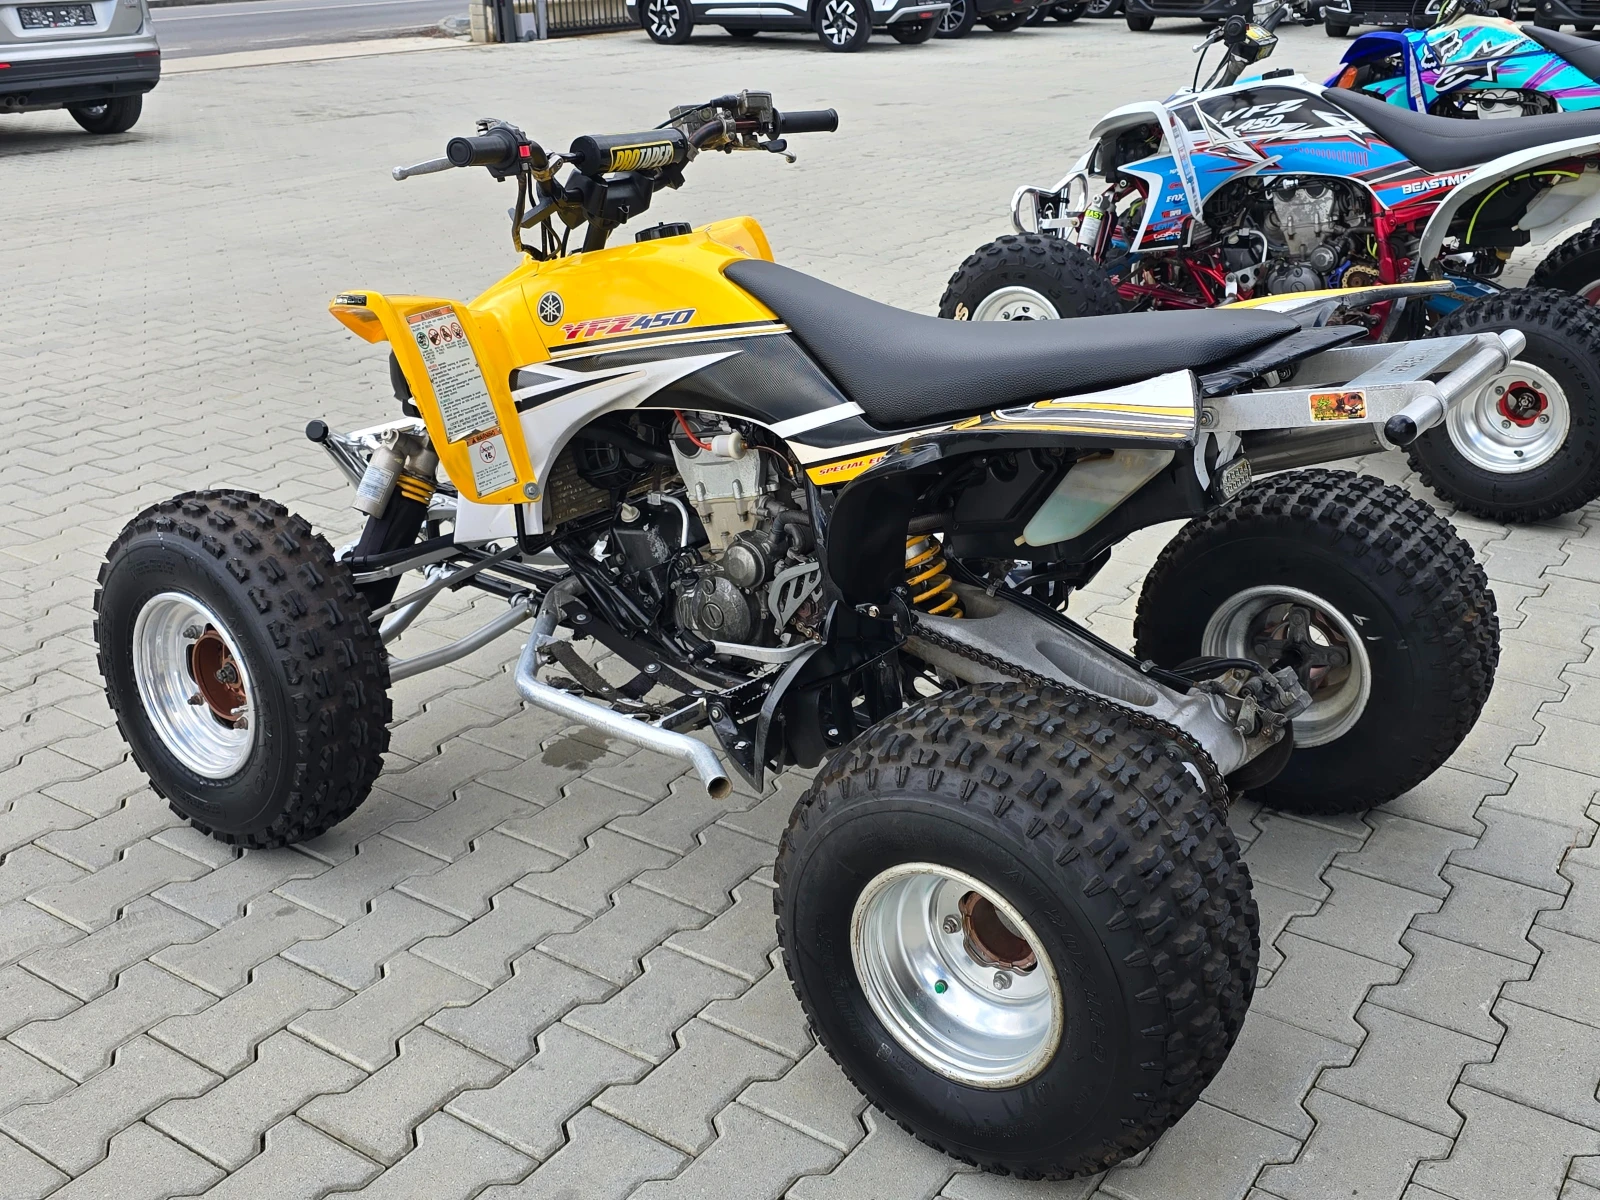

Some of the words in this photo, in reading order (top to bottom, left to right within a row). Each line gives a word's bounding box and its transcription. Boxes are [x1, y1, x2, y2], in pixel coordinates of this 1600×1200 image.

[1220, 98, 1308, 123] YFZ
[1236, 114, 1285, 131] 450
[613, 145, 672, 172] PROTAPER
[1401, 172, 1472, 195] BEASTMO
[819, 460, 865, 475] SPECIAL
